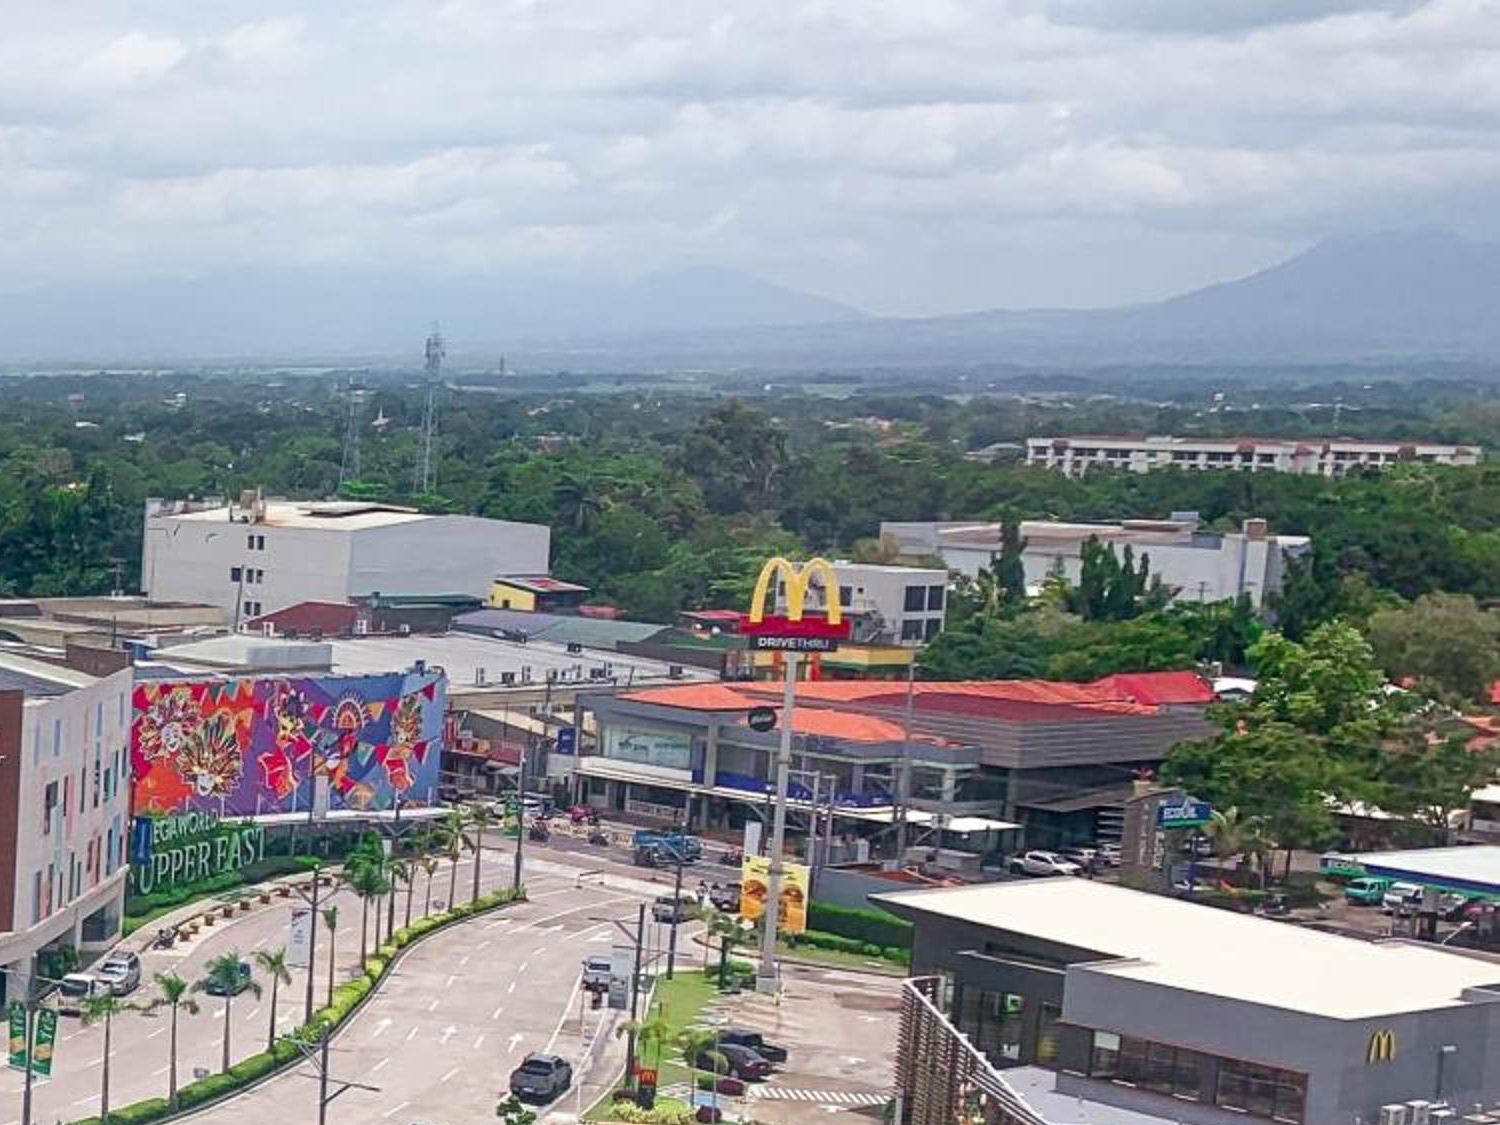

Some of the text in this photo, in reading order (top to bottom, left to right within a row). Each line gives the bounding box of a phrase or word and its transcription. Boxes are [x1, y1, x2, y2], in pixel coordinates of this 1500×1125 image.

[150, 808, 220, 843] EGAWORLD
[139, 827, 266, 894] UPPER EAST
